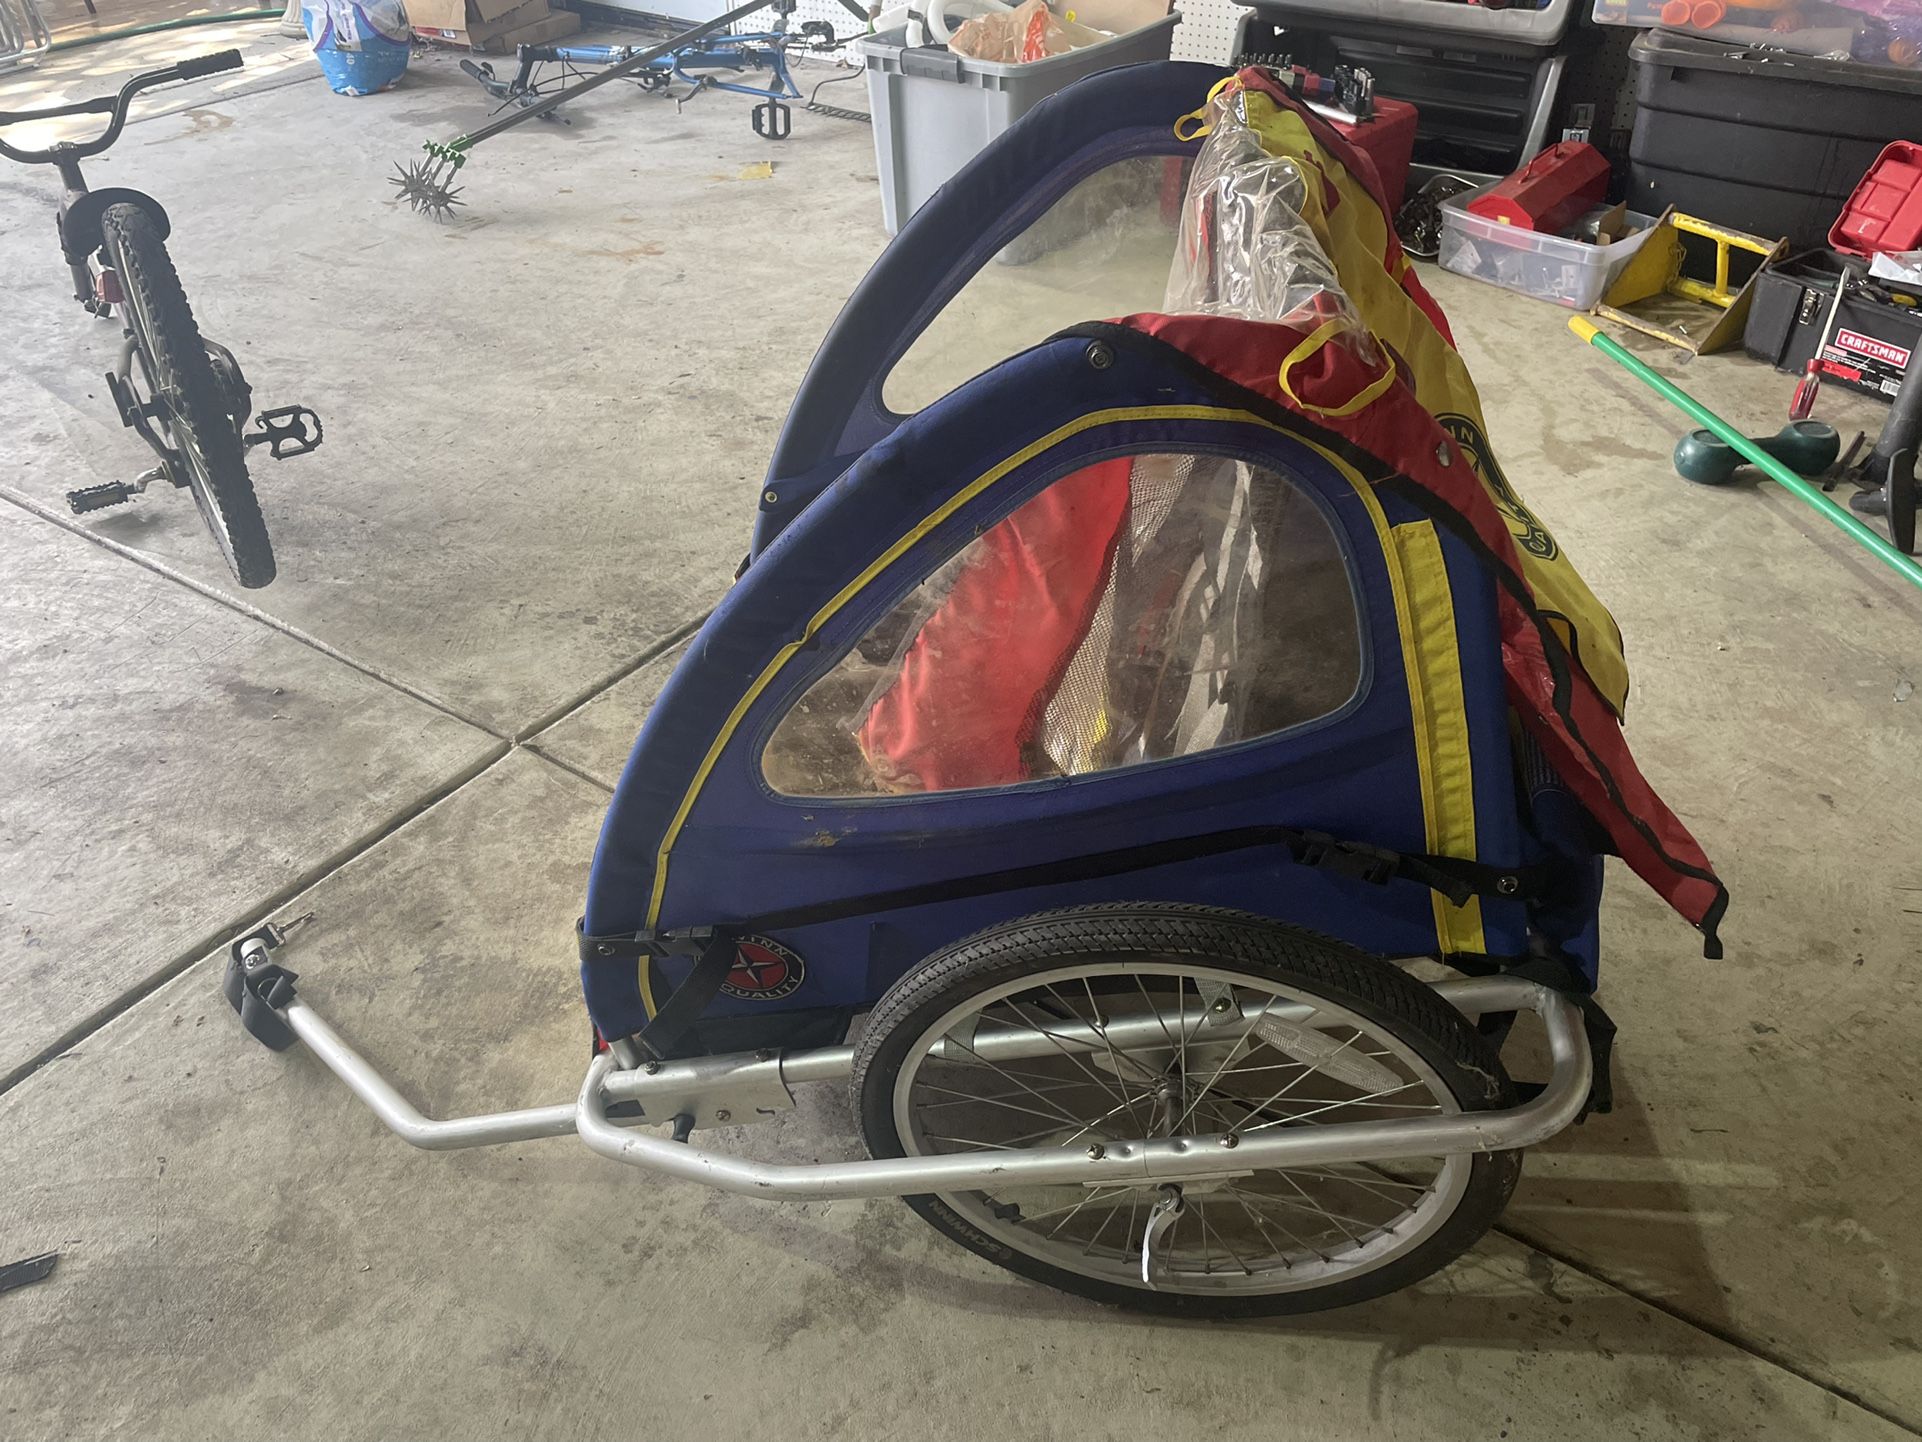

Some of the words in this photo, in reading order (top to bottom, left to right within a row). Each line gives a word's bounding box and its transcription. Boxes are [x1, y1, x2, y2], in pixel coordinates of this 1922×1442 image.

[1841, 333, 1907, 363] CRAFTSMAN
[720, 975, 799, 999] QUALITY
[928, 1200, 1002, 1253] SCHWINN
